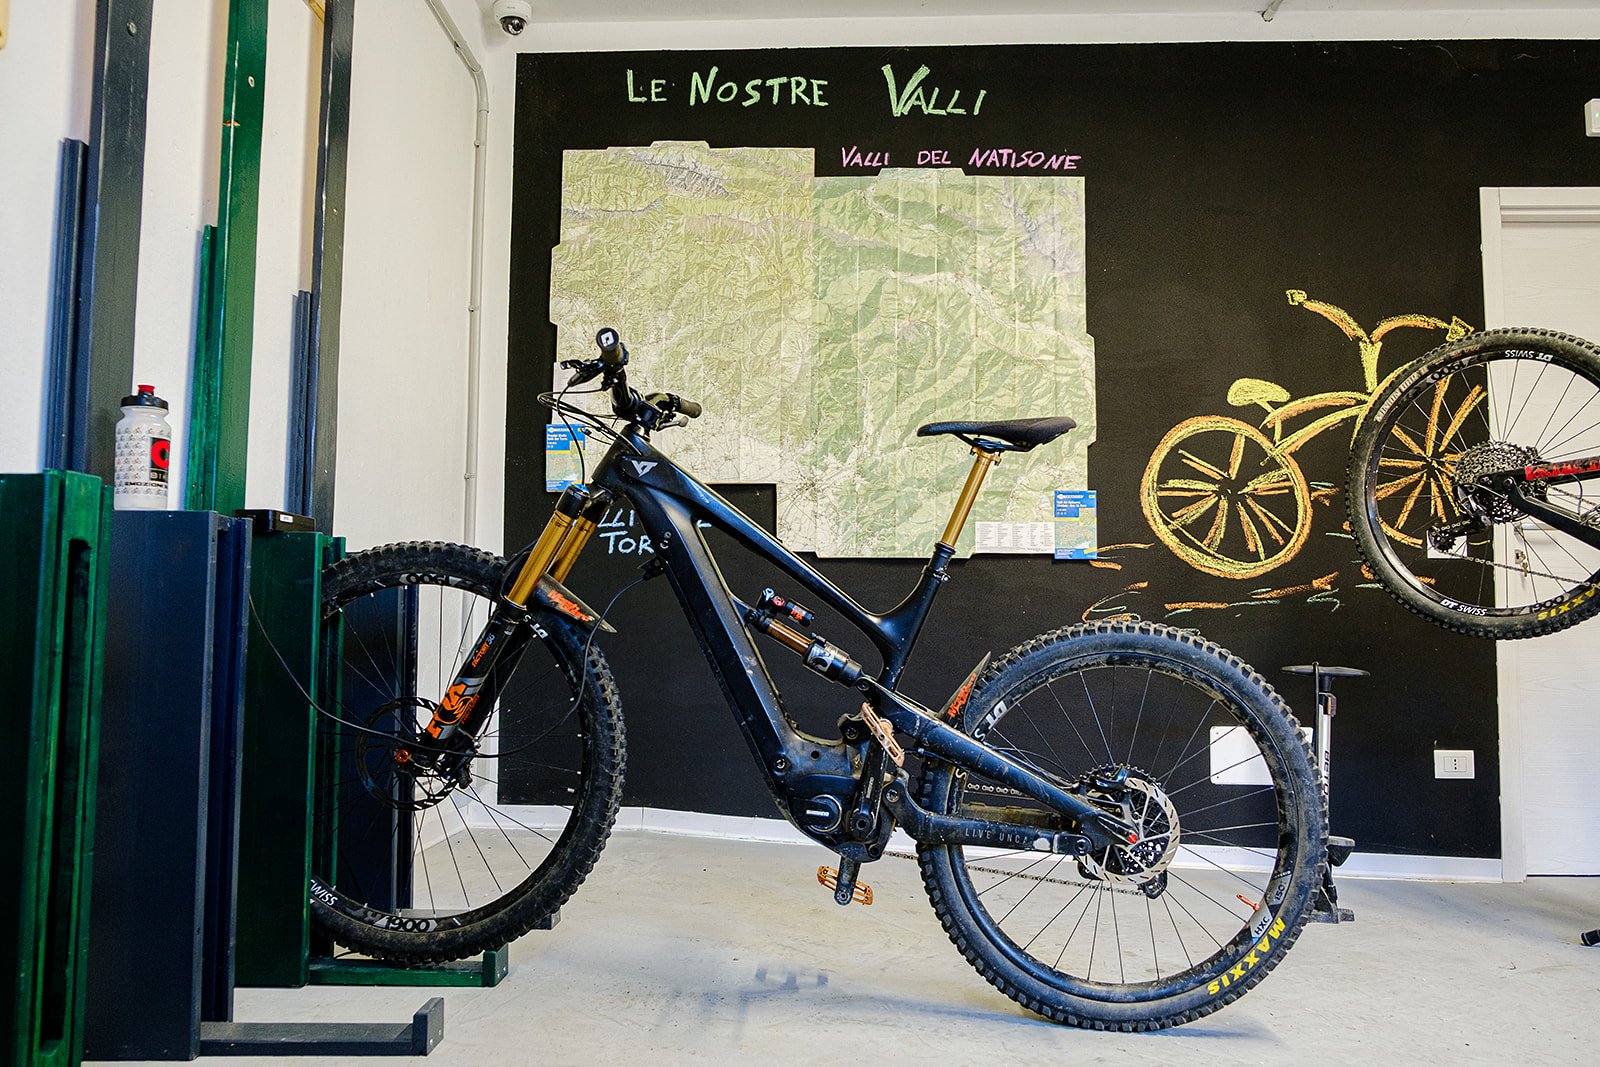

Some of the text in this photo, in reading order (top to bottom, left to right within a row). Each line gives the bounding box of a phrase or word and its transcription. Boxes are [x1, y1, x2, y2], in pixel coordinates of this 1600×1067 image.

[626, 64, 987, 117] LE NOSTRE VALLI
[842, 146, 1081, 170] VALLI DEL NATISONE
[597, 508, 635, 528] LLI
[599, 530, 654, 555] TOR
[1440, 598, 1488, 616] DT SWISS
[1536, 590, 1596, 621] AXXIS
[965, 828, 992, 840] LIVE
[384, 915, 432, 932] 1900
[1254, 916, 1270, 936] HXC
[1207, 917, 1286, 996] MAXXIS
